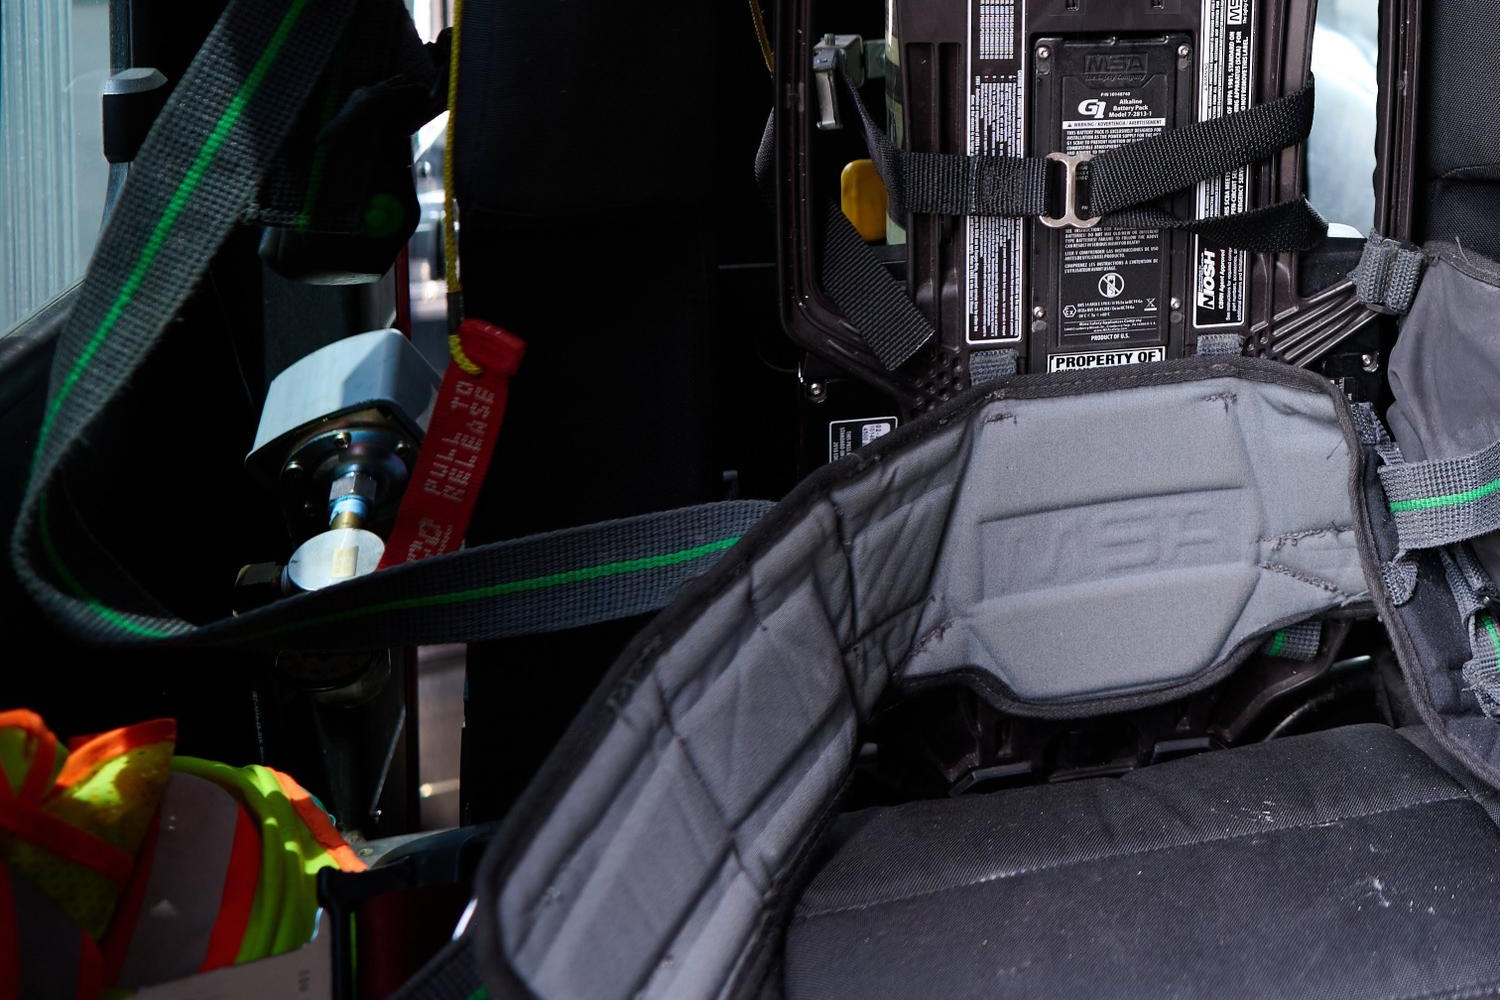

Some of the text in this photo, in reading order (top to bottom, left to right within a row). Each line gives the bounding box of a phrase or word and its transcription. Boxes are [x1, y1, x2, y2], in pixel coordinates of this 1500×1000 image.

[1230, 32, 1234, 40] ON
[1086, 56, 1144, 72] MSA
[1078, 99, 1106, 118] G1
[1198, 251, 1215, 309] NIOSH
[1056, 351, 1156, 368] PROPERTY OF
[423, 432, 466, 496] PULL
[450, 380, 474, 411] TO
[441, 385, 496, 502] RELEASE
